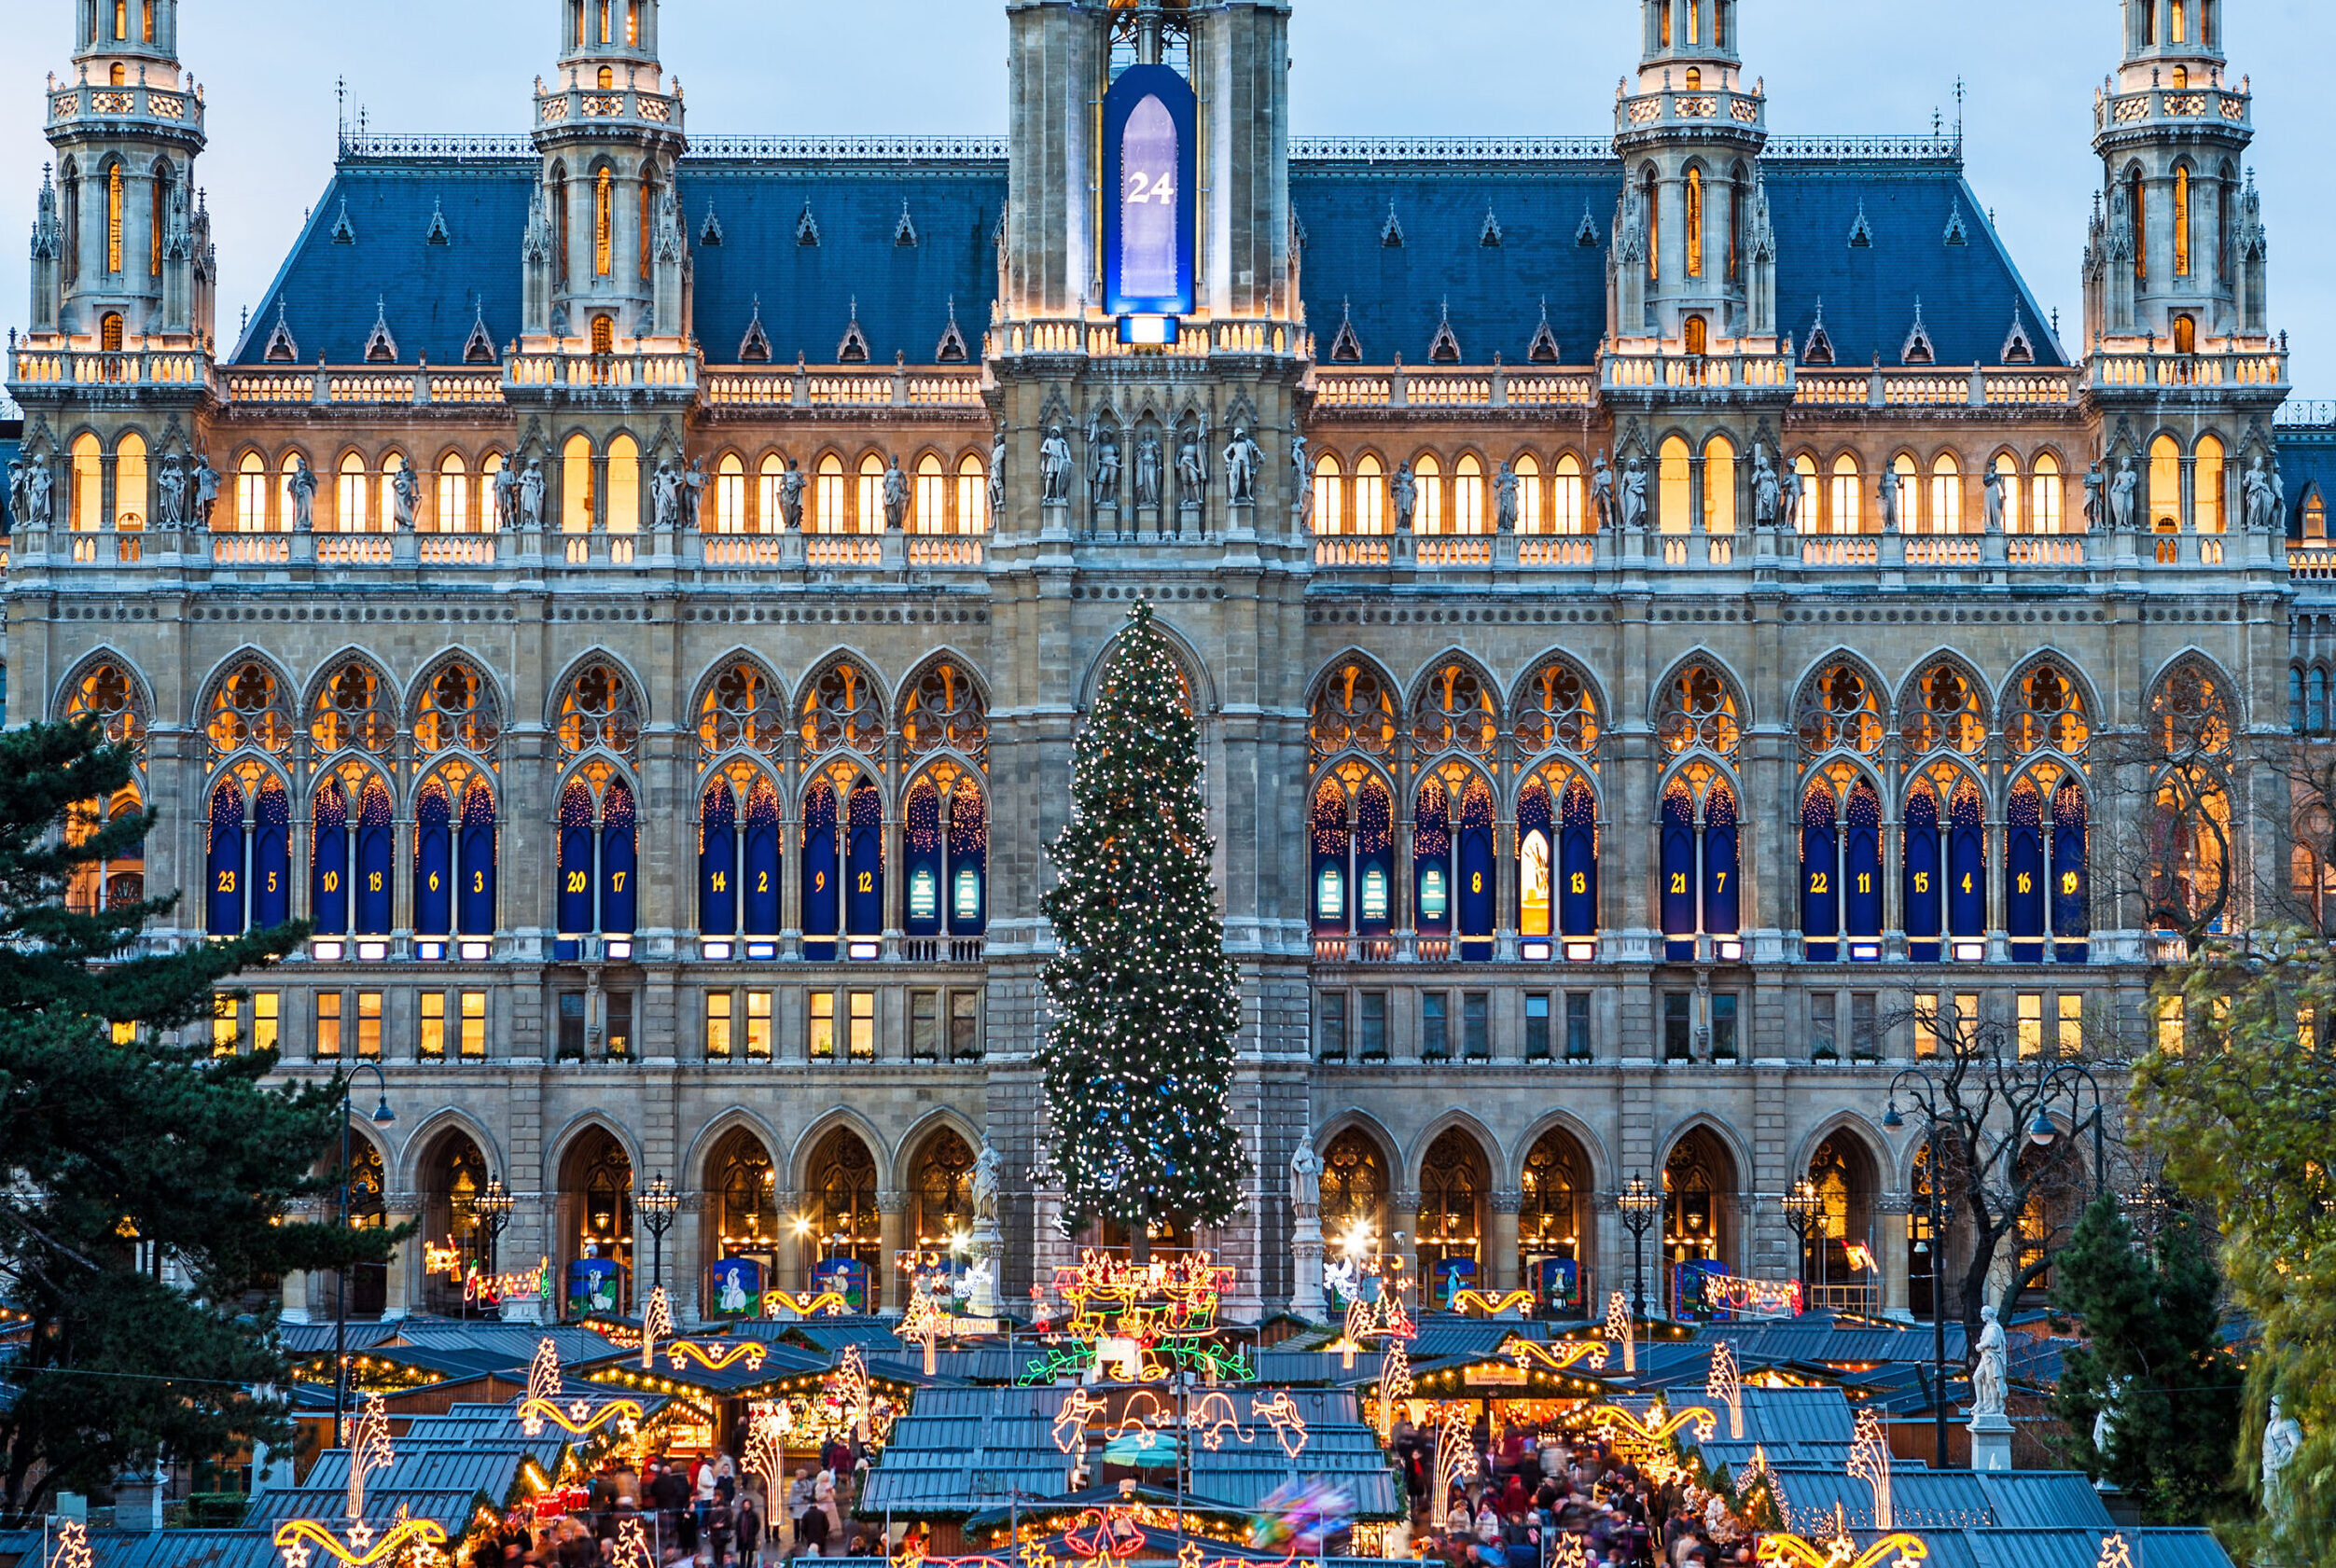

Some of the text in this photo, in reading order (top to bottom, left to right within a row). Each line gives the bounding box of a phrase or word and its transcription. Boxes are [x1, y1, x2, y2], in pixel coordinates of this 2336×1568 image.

[1126, 172, 1175, 205] 24
[217, 870, 235, 893] 23
[268, 871, 276, 893] 5
[323, 870, 338, 893] 10
[368, 871, 382, 893] 18
[429, 871, 438, 893] 6
[474, 871, 483, 893] 3
[567, 871, 586, 893] 20
[612, 871, 627, 893] 17
[711, 871, 726, 892] 14
[758, 871, 768, 893] 2
[815, 871, 825, 893] 9
[857, 871, 872, 893] 12
[1471, 871, 1482, 894] 8
[1571, 871, 1586, 894] 13
[1671, 872, 1686, 894] 21
[1717, 872, 1727, 894] 7
[1810, 872, 1828, 894] 22
[1857, 872, 1870, 894] 11
[1913, 872, 1928, 893] 15
[1962, 872, 1972, 894] 4
[2017, 872, 2032, 894] 16
[2062, 871, 2078, 895] 19
